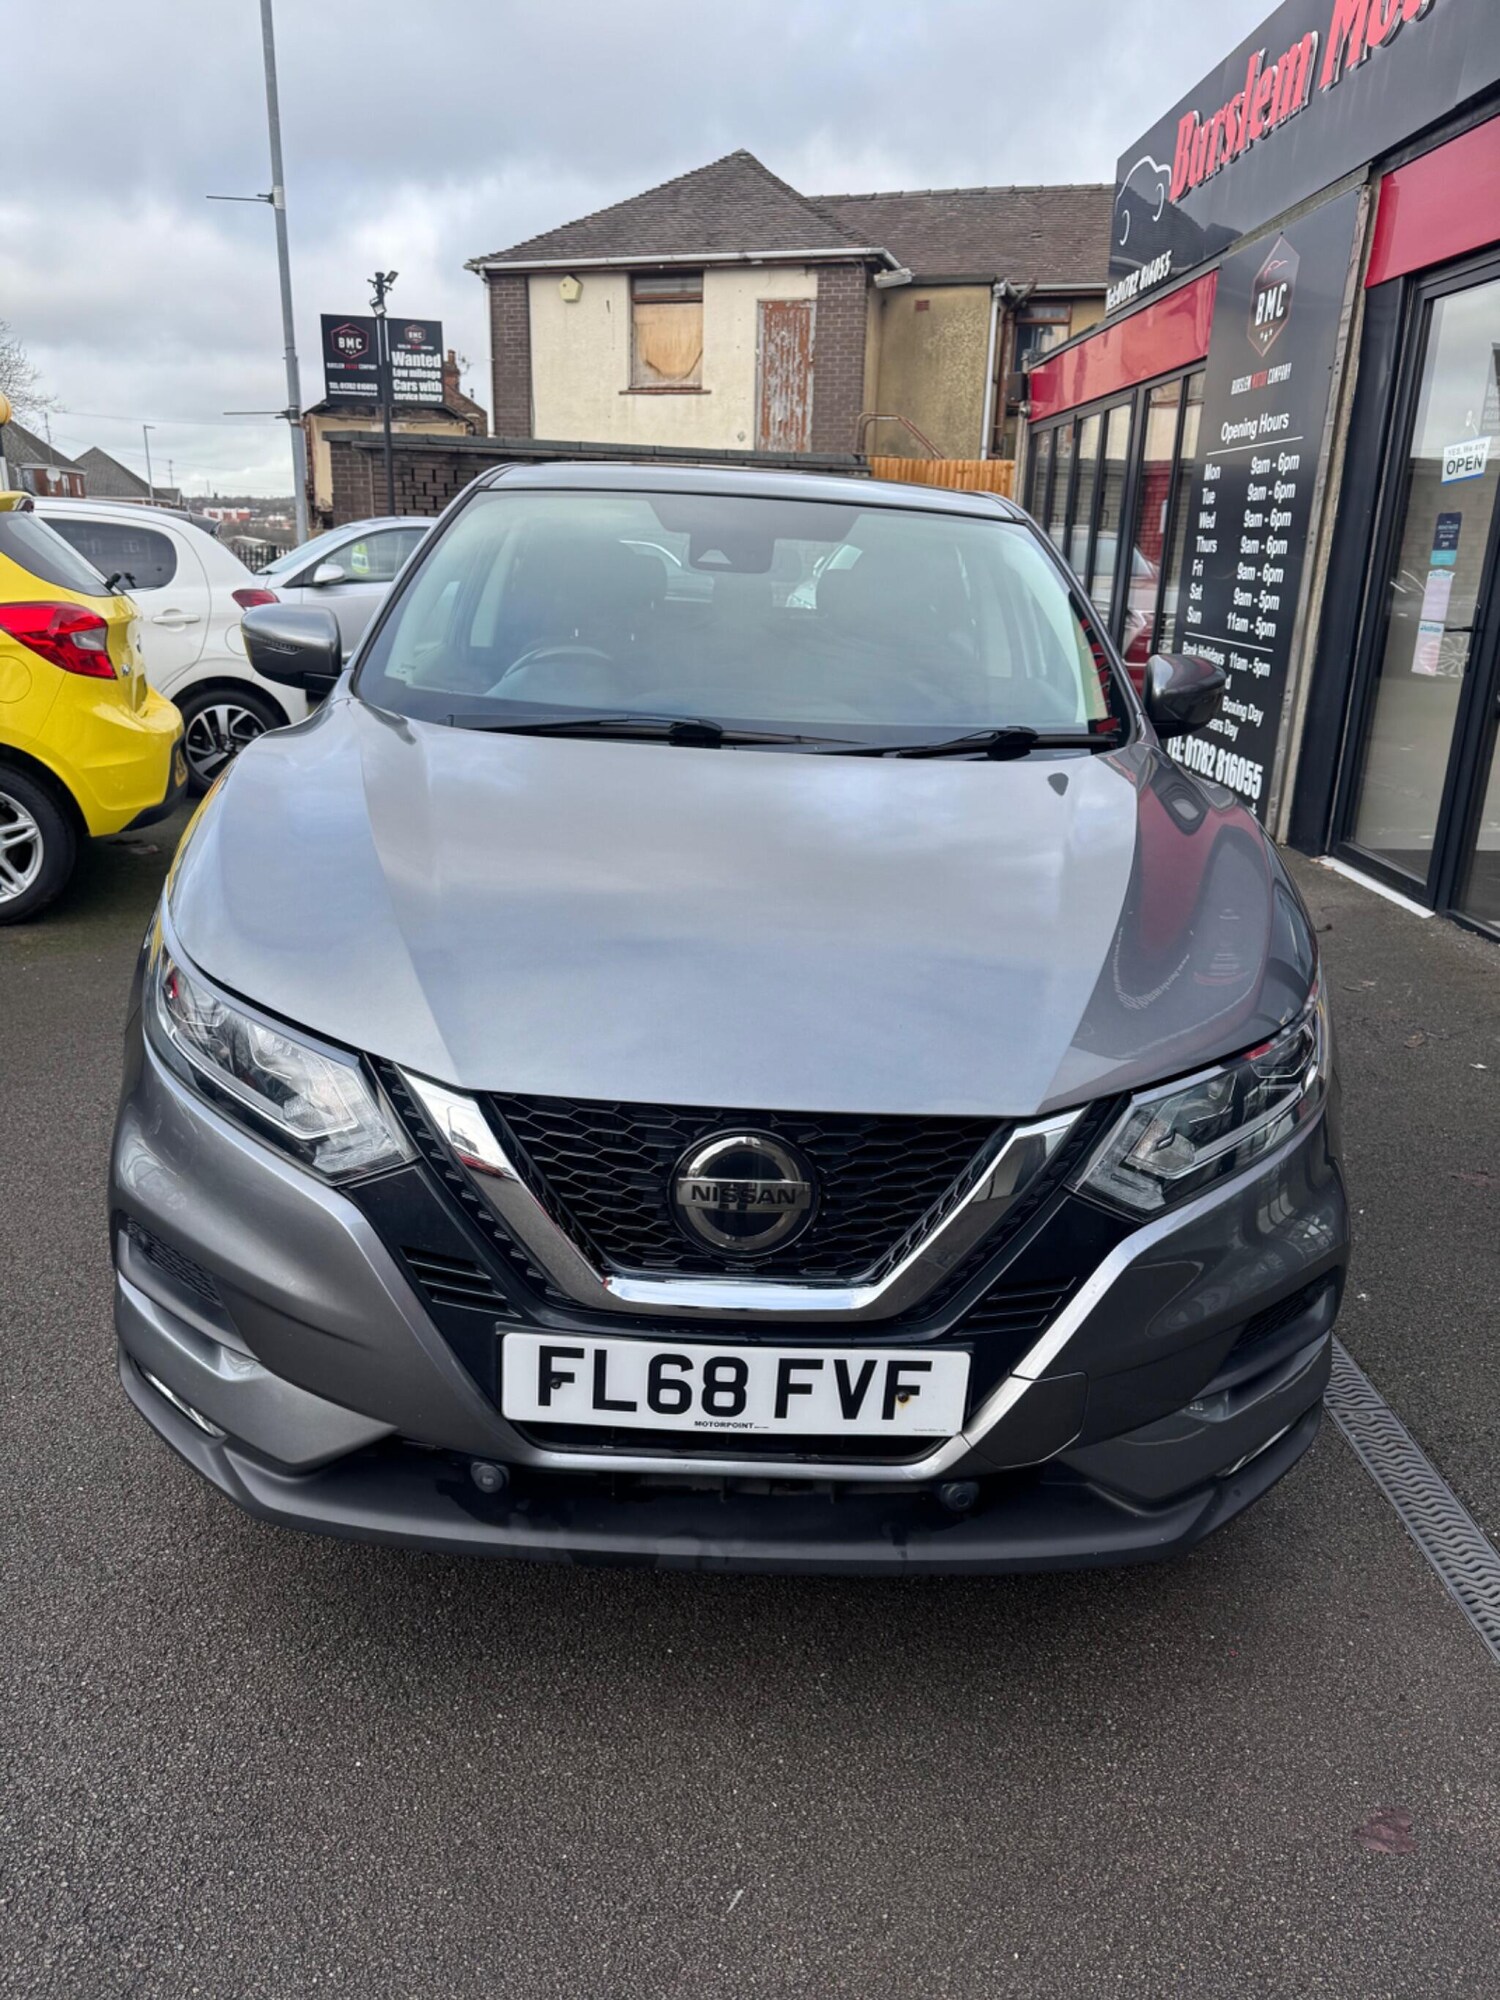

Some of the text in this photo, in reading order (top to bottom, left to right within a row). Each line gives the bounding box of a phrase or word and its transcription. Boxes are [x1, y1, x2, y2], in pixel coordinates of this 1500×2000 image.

[1169, 0, 1432, 203] Burslem Mo
[1140, 250, 1171, 290] 816055
[1255, 282, 1287, 326] BMC
[338, 337, 362, 349] BMC
[391, 350, 442, 368] Wanted
[392, 367, 441, 380] Low mileage
[392, 379, 442, 393] Cars with
[1221, 412, 1290, 444] Opening Hours
[1204, 464, 1221, 481] Mon
[1250, 456, 1270, 475] 9am
[1278, 452, 1300, 476] 6pm
[1447, 452, 1484, 475] OPEN
[1202, 488, 1216, 505] Tue
[1247, 483, 1267, 501] 9am
[1274, 481, 1296, 503] 6pm
[1199, 511, 1216, 529] Wed
[1243, 510, 1263, 528] 9am
[1270, 508, 1292, 531] 6pm
[1196, 536, 1217, 553] Thurs
[1240, 536, 1260, 554] 9am
[1266, 535, 1288, 559] 6pm
[1192, 560, 1204, 576] Fri
[1237, 562, 1256, 580] 9am
[1262, 563, 1284, 586] 6pm
[1190, 582, 1203, 600] Sat
[1233, 587, 1252, 607] 9am
[1259, 590, 1280, 613] 5pm
[1187, 605, 1202, 624] Sun
[1227, 612, 1249, 632] 11am
[1255, 616, 1276, 640] 5pm
[1229, 652, 1248, 672] 11am
[1252, 657, 1271, 679] 5pm
[1222, 695, 1264, 727] Boxing Day
[1206, 719, 1239, 741] ears Day
[1185, 735, 1216, 778] 01782
[1215, 748, 1263, 800] 816055
[692, 1185, 796, 1204] NISSAN
[538, 1344, 933, 1421] FL68 FVF
[694, 1420, 754, 1429] MOTORPOINT
